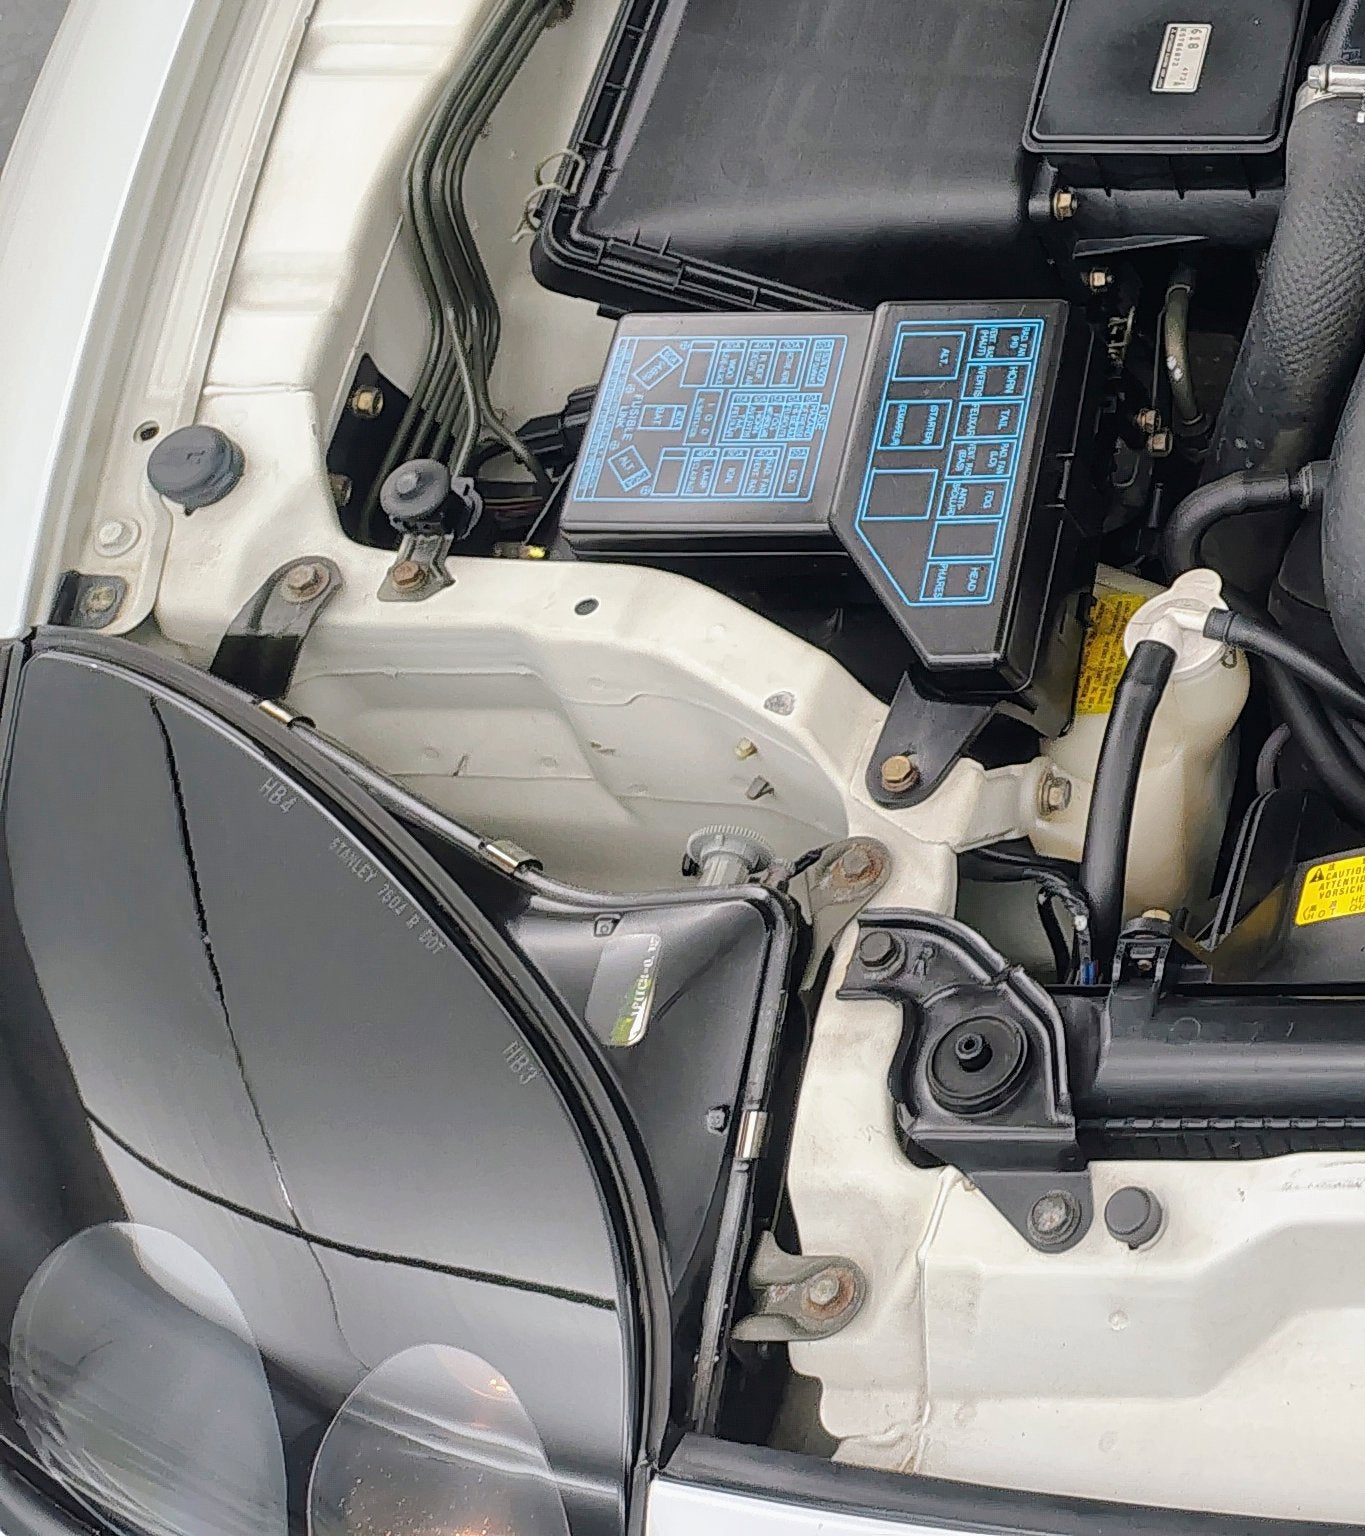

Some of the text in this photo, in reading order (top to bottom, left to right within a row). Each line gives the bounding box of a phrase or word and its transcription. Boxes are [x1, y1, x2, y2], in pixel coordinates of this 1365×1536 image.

[1189, 28, 1201, 50] 618
[939, 348, 949, 365] ALT.
[1005, 367, 1018, 393] HORN
[614, 406, 629, 428] LINK
[623, 394, 642, 441] FUSIBLE
[922, 405, 938, 444] (STARTER)
[998, 410, 1010, 429] TAIL
[983, 491, 994, 508] FOG
[934, 562, 948, 598] PHARES
[967, 567, 980, 591] HEAD
[260, 777, 298, 813] HB4
[328, 838, 375, 884] STANLEY
[503, 1041, 539, 1085] HB3
